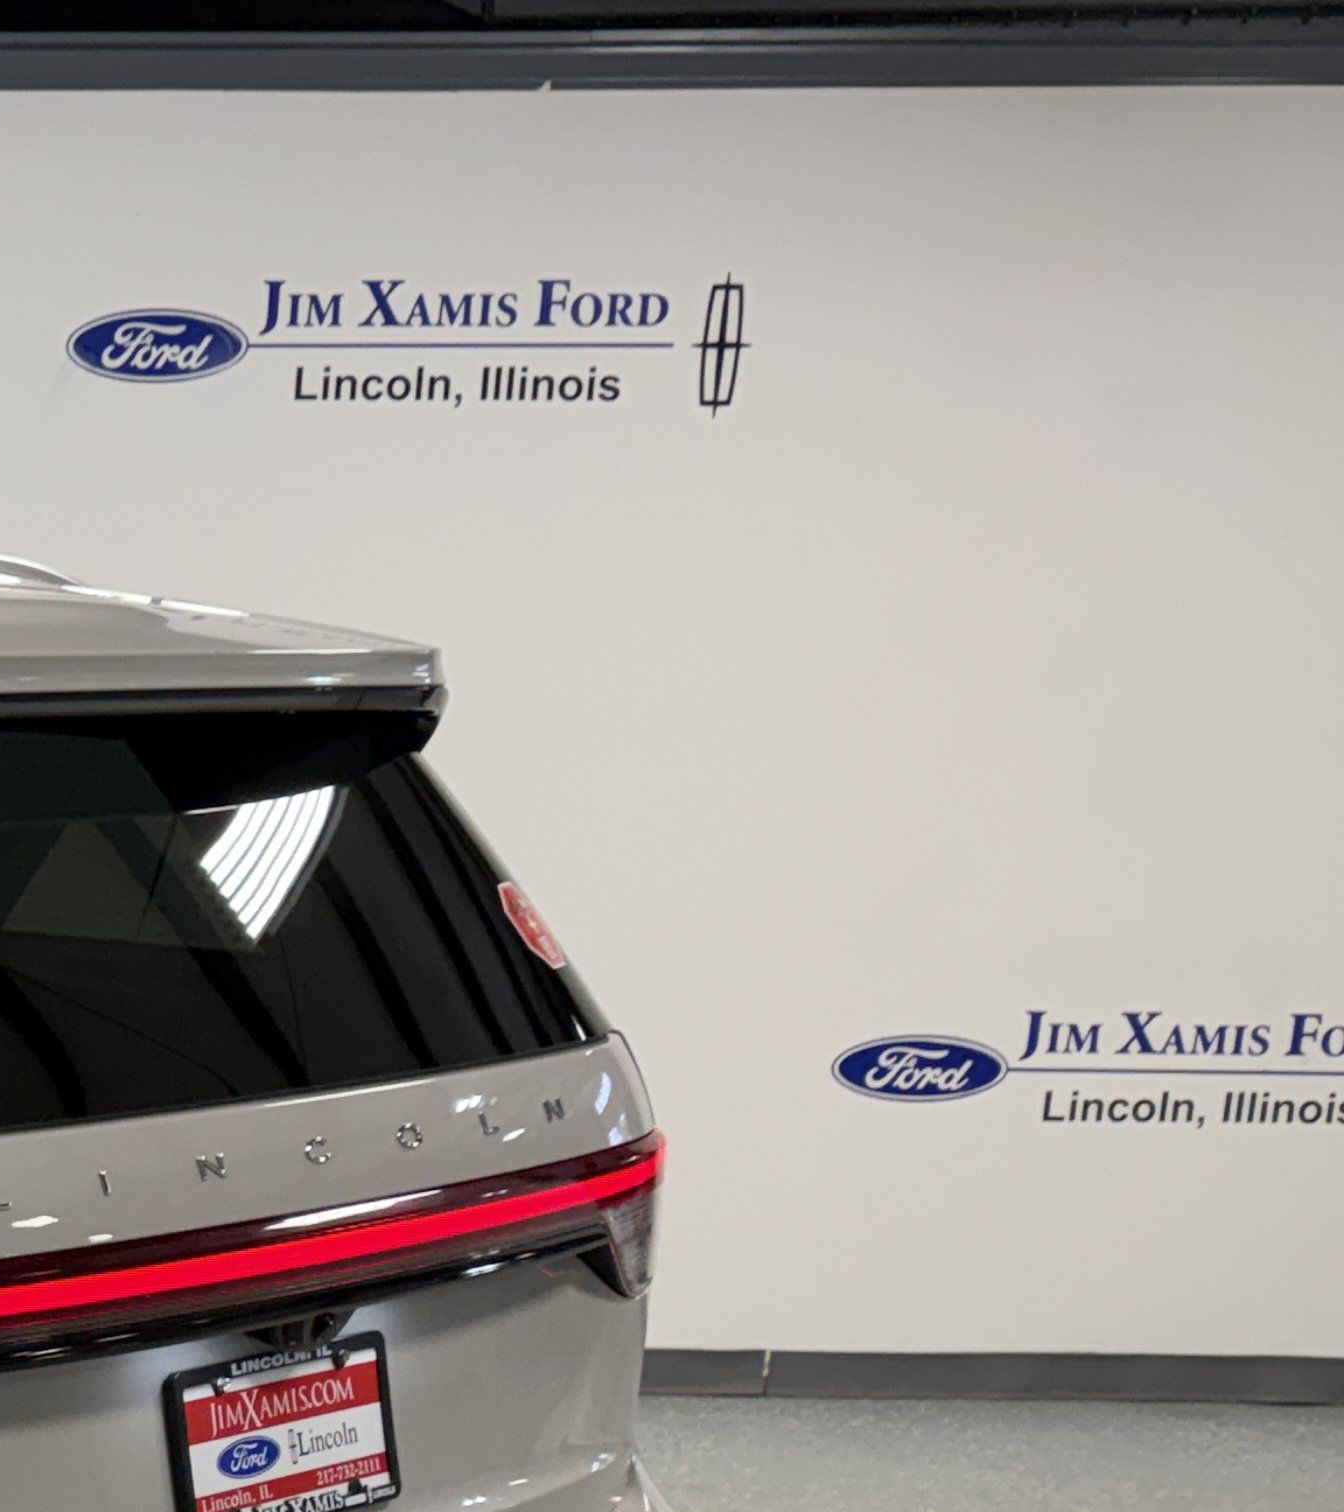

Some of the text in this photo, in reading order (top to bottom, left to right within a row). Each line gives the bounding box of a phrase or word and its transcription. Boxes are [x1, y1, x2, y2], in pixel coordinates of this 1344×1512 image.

[259, 279, 670, 336] JIM XAMIS FORD
[101, 322, 209, 371] Ford
[293, 365, 621, 408] Lincoln, Illinois
[1018, 1010, 1102, 1061] JIM
[1115, 1011, 1270, 1056] XAMIS
[864, 1046, 970, 1091] Ford
[1041, 1090, 1206, 1129] Lincoln,
[296, 1421, 359, 1457] Lincoln
[259, 1484, 274, 1500] IL
